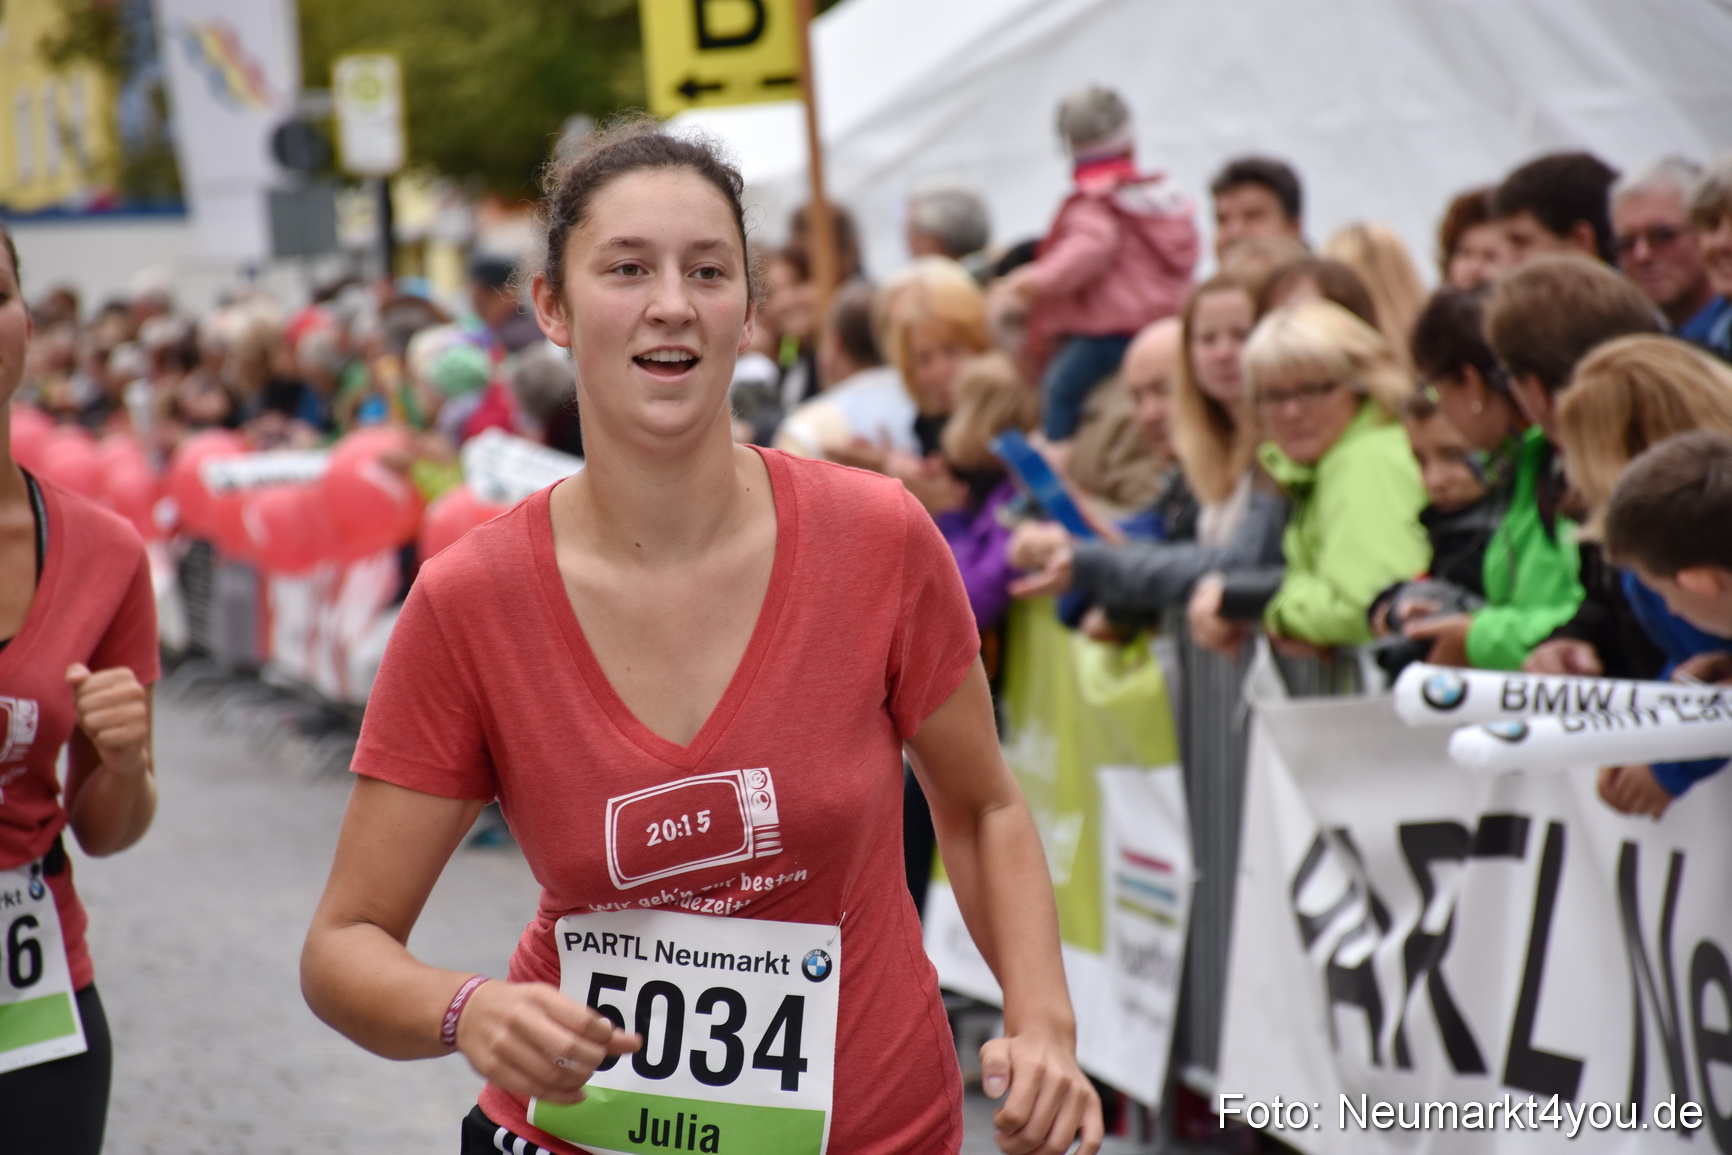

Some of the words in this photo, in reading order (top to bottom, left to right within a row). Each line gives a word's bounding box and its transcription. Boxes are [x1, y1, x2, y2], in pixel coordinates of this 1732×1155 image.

[1501, 679, 1615, 713] BMW
[646, 809, 711, 847] 20:15
[563, 931, 648, 962] PARTL
[654, 939, 791, 976] Neumarkt
[585, 971, 809, 1093] 5034
[627, 1107, 721, 1154] Julia
